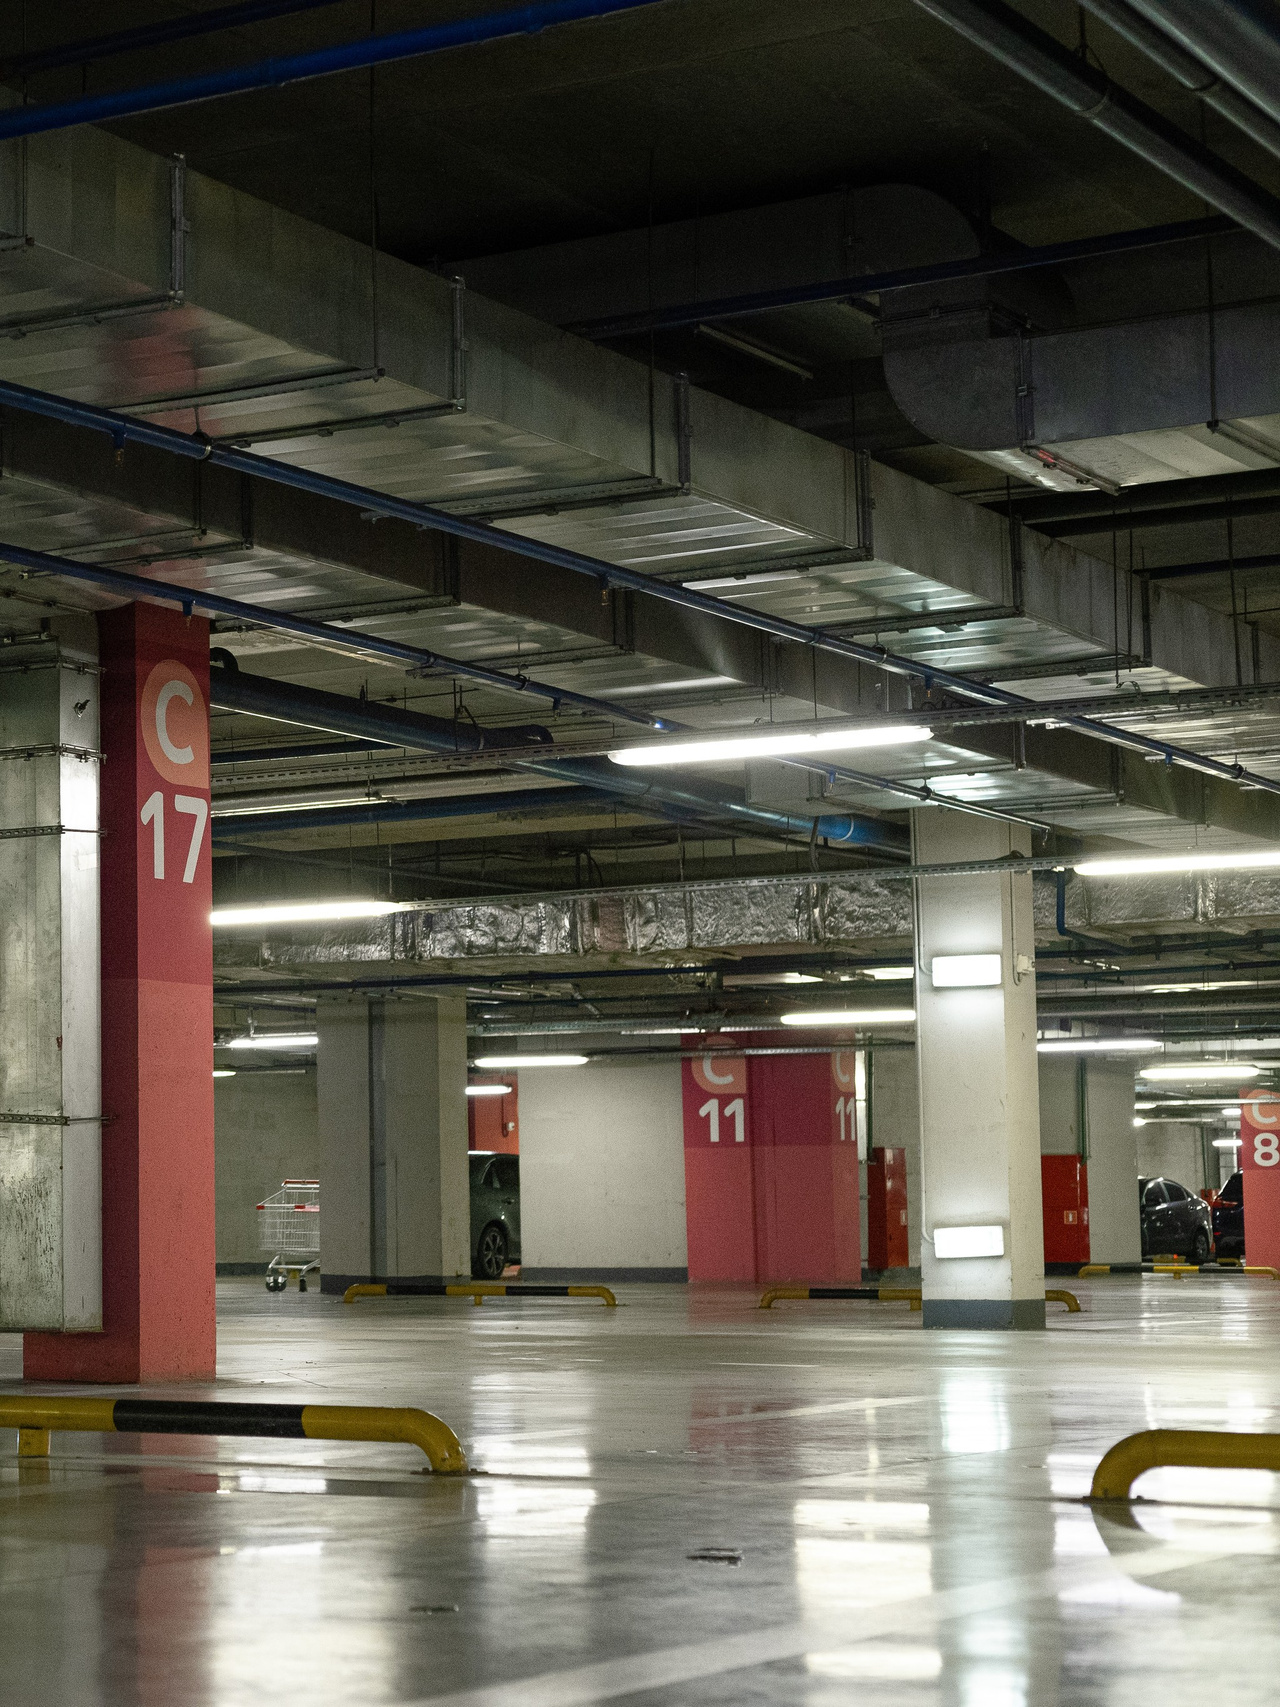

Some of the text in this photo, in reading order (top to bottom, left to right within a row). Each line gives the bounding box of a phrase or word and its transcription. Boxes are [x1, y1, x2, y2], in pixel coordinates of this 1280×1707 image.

[156, 680, 194, 764] C
[140, 791, 208, 883] 17
[703, 1052, 734, 1085] C
[836, 1052, 850, 1083] C
[699, 1098, 745, 1142] 11
[836, 1096, 856, 1142] 11
[1252, 1094, 1278, 1124] C
[1253, 1132, 1280, 1167] 8
